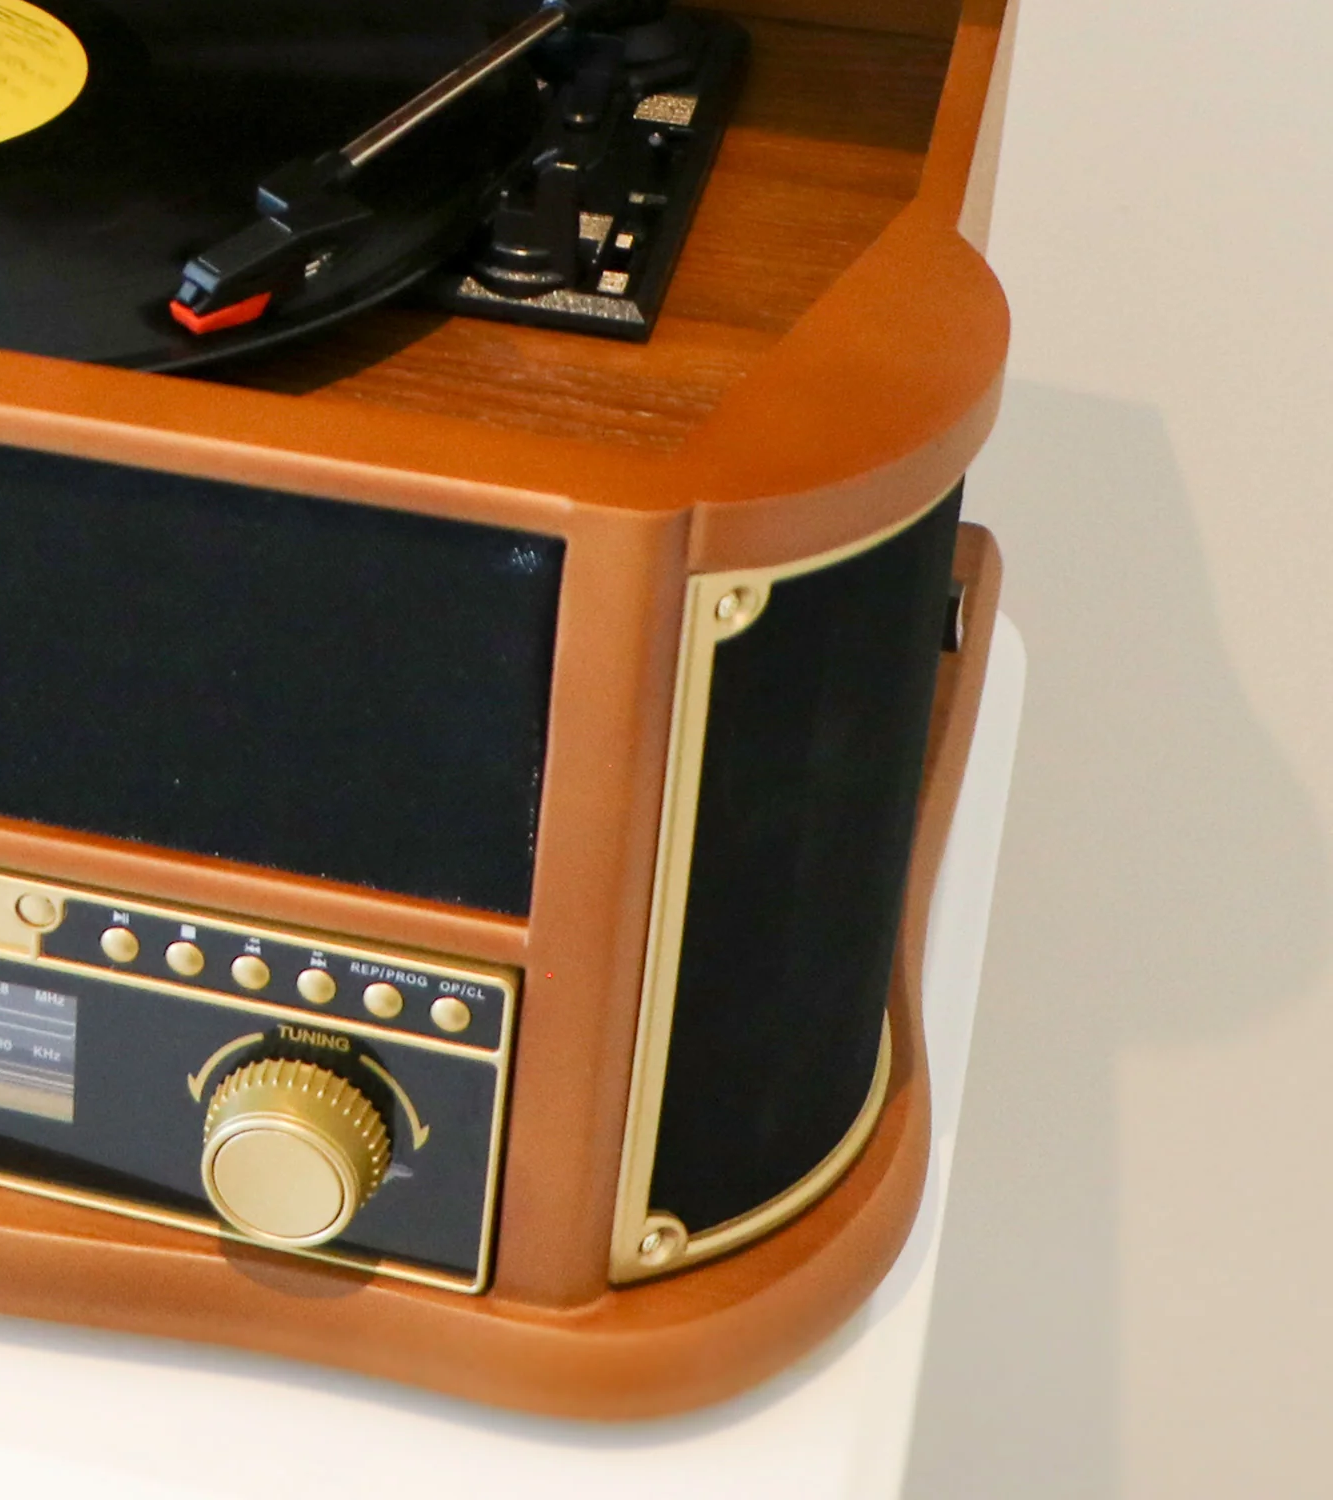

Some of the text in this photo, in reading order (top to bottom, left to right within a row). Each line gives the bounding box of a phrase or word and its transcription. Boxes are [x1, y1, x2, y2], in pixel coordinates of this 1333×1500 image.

[350, 961, 428, 987] REP/PROG
[35, 990, 65, 1007] MHz
[439, 980, 485, 1000] OP/CL
[277, 1024, 350, 1051] TUNING
[33, 1046, 61, 1061] KHz
